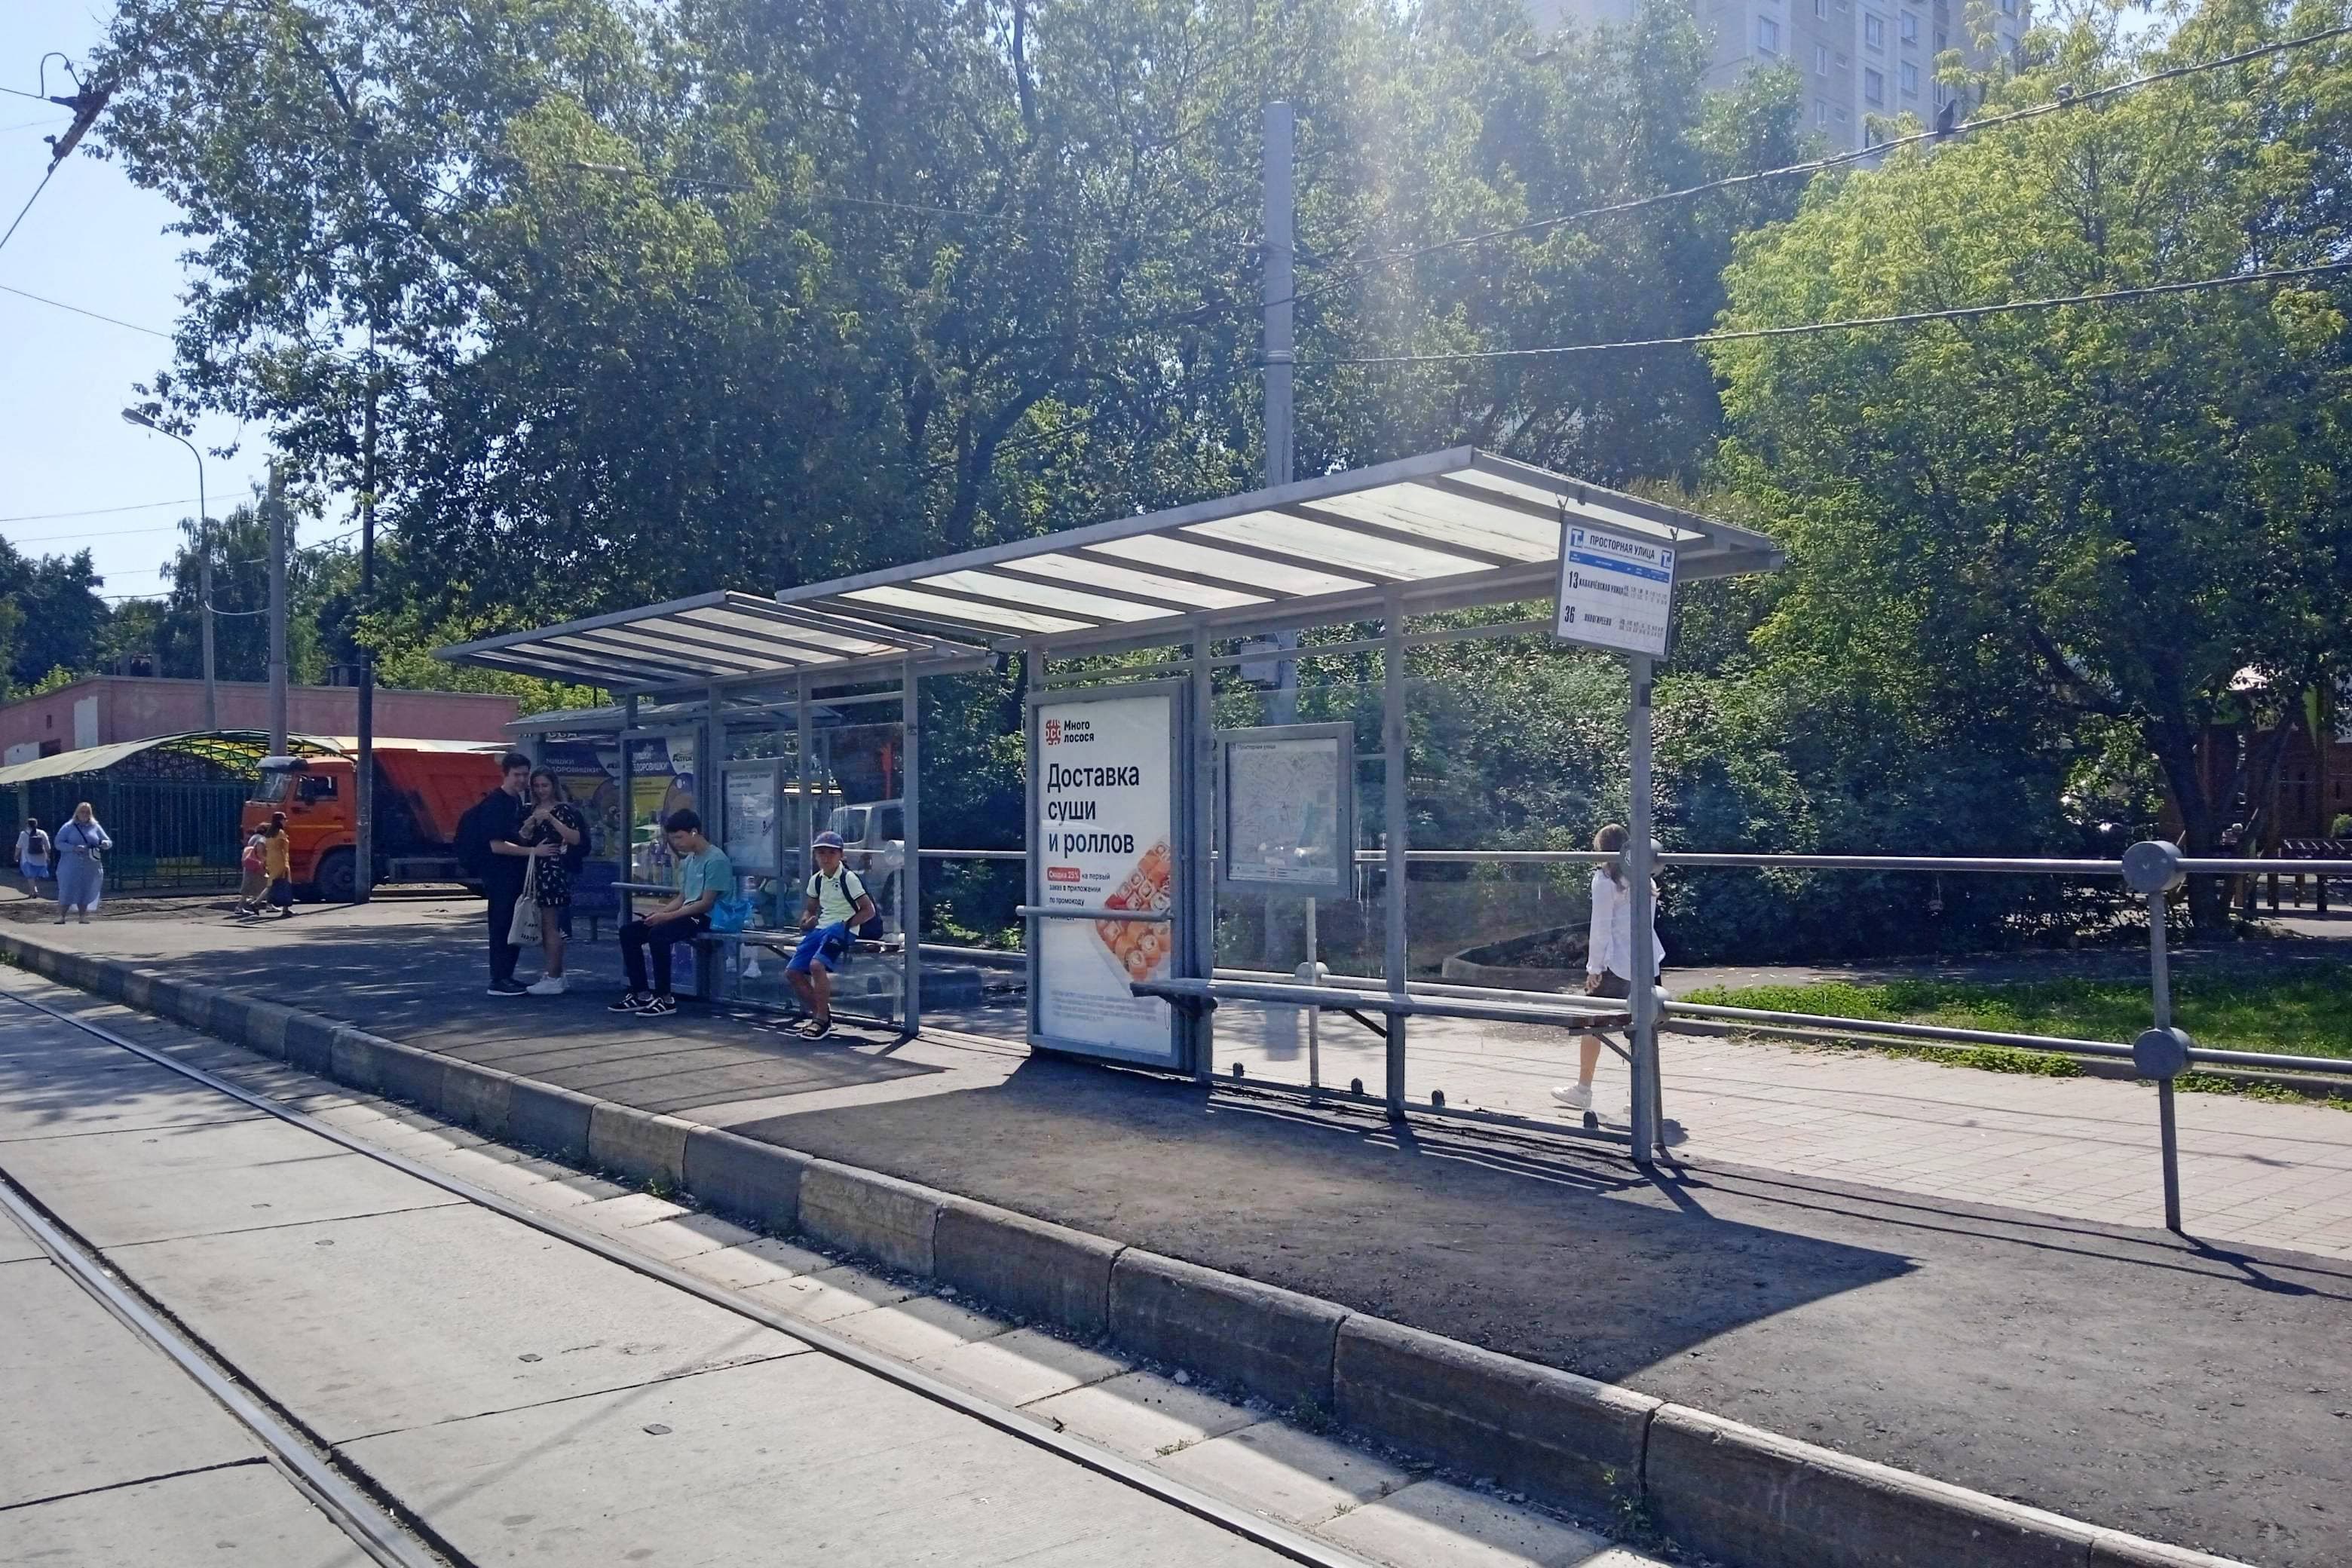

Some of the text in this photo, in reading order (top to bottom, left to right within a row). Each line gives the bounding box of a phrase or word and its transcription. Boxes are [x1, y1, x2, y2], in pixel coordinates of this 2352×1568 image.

[1590, 535, 1655, 560] ПРОСТОРНАЯ УЛИЦА
[1569, 571, 1579, 589] 13
[1565, 605, 1612, 626] 36 НОВОГИРЕЕВО
[1064, 719, 1090, 731] Много
[1064, 732, 1095, 743] лосося
[1047, 763, 1140, 793] Доставка
[1048, 800, 1096, 826] суши
[1049, 833, 1135, 859] и роллов
[1089, 873, 1110, 881] первый
[1056, 897, 1085, 906] промокоду
